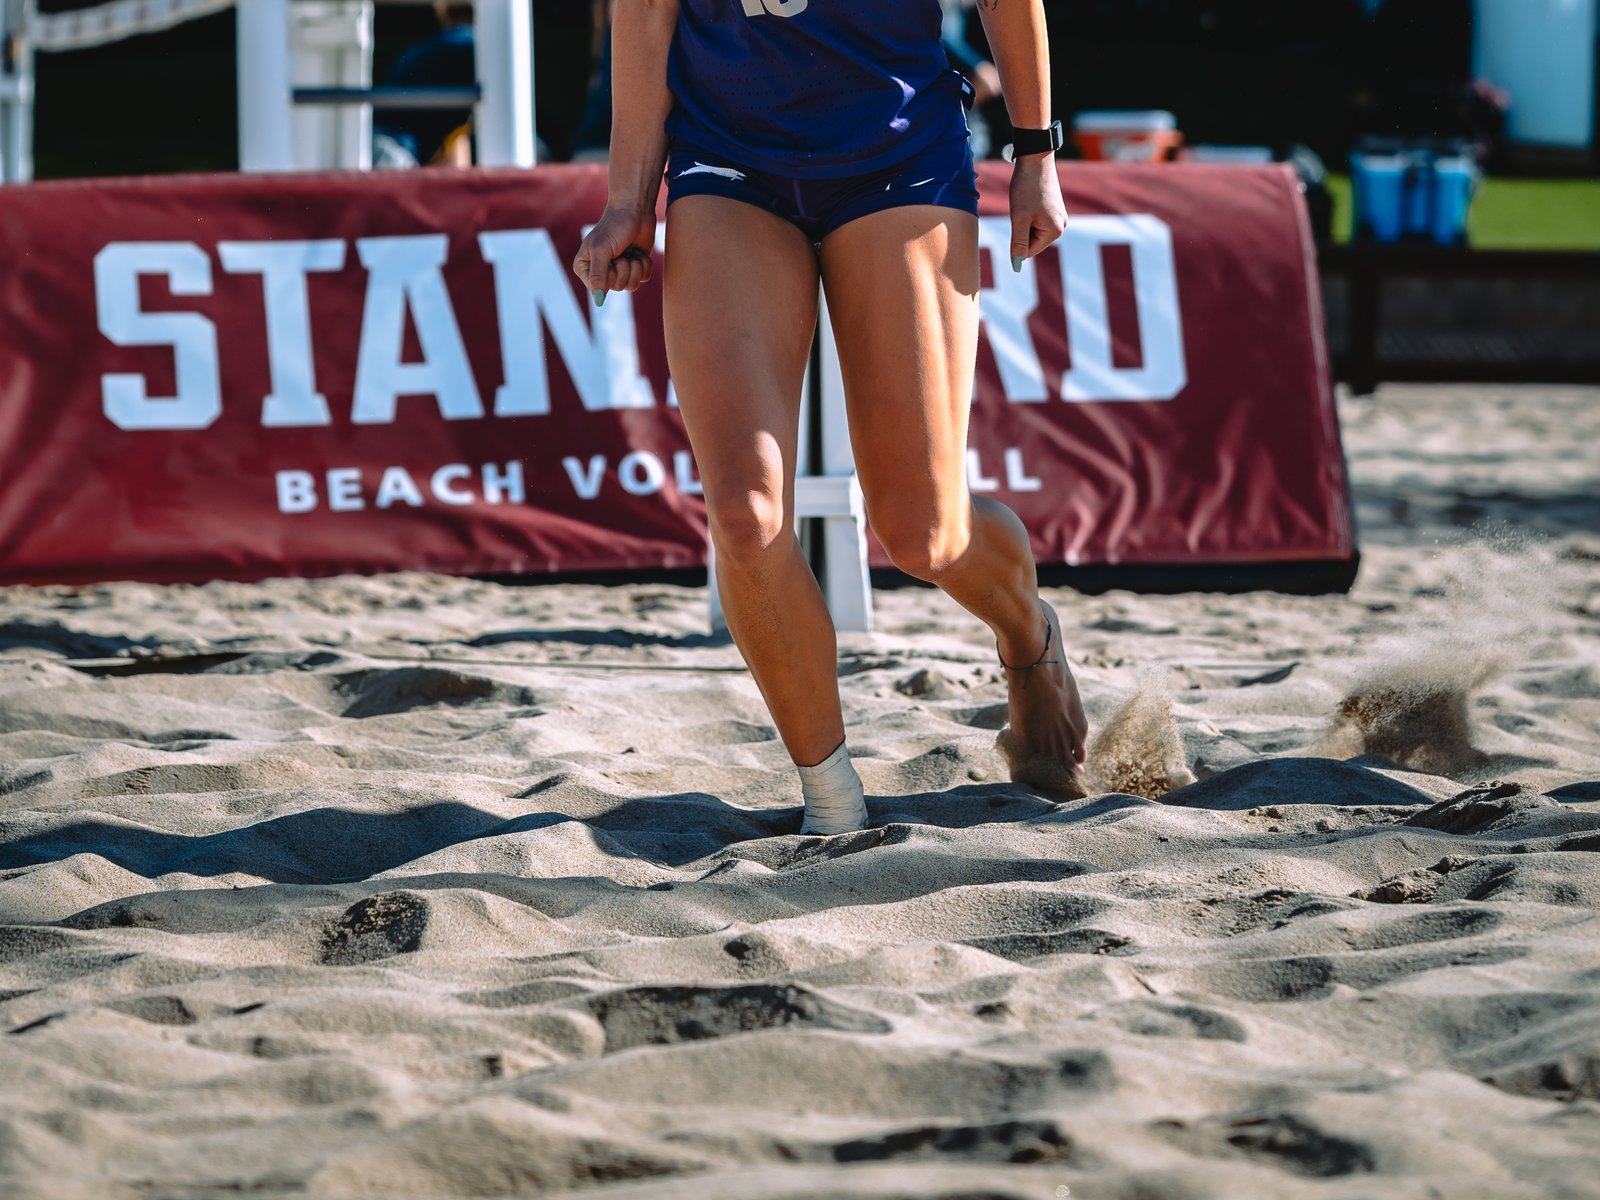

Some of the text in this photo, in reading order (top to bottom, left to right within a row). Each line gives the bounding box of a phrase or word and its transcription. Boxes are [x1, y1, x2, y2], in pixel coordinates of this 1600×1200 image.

[94, 213, 1187, 430] STANRD
[275, 447, 1041, 514] BEACH VOLLL
